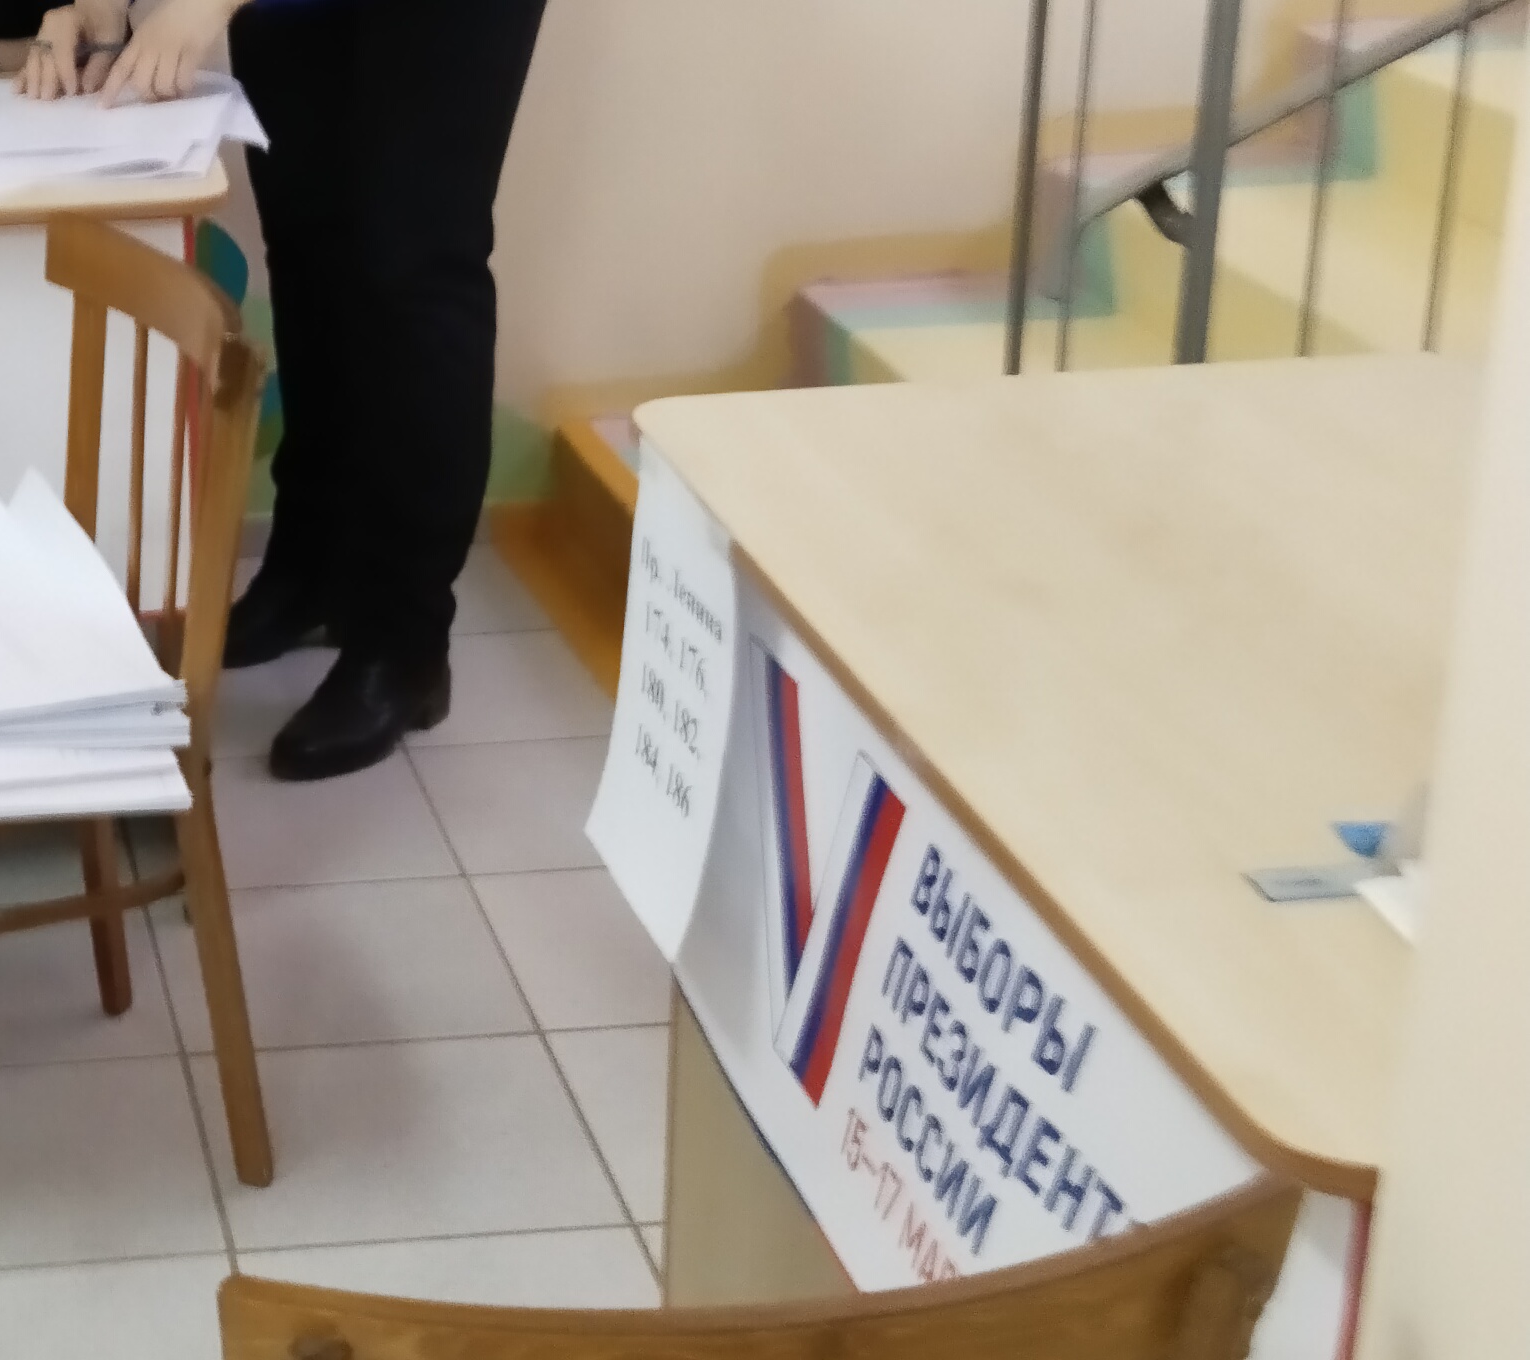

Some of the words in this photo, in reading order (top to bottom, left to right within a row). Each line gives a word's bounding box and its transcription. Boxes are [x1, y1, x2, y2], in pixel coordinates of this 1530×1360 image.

[881, 937, 1149, 1242] ПРЕЗИДЕНТ
[911, 843, 1098, 1092] ВЫБОРЫ
[858, 1024, 998, 1256] РОССИИ
